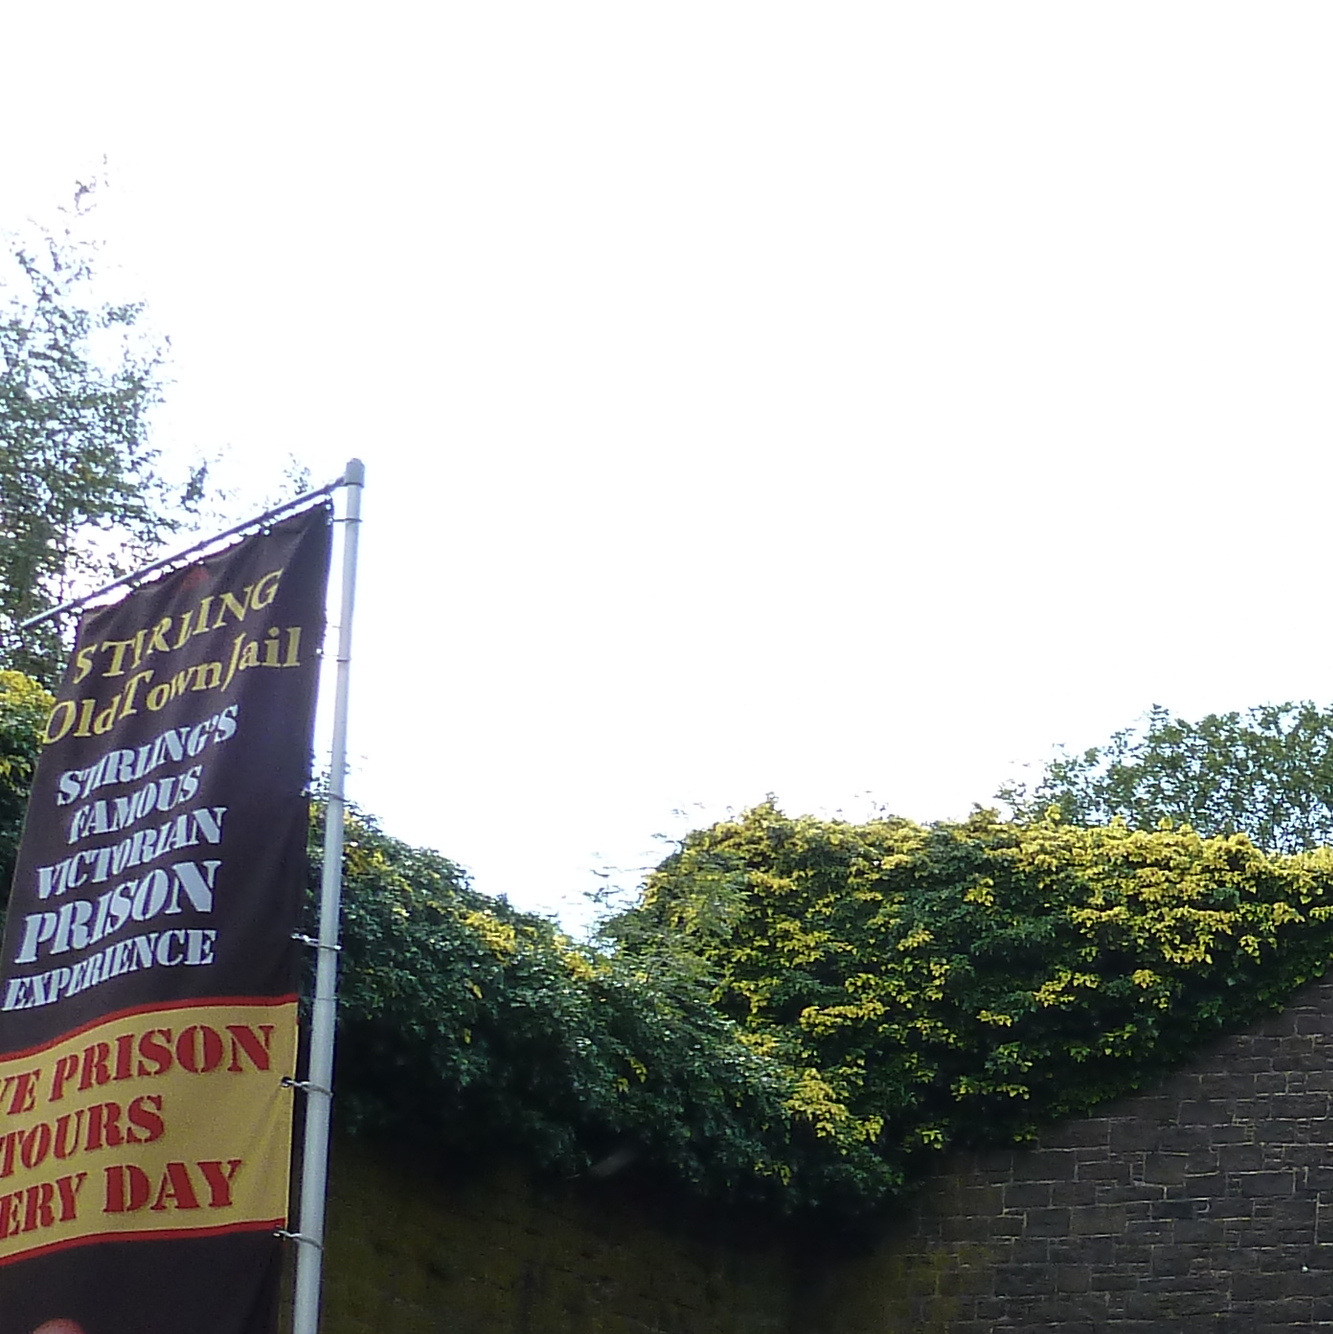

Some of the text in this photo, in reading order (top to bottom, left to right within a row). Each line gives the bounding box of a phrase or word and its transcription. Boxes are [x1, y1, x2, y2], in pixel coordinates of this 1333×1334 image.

[73, 568, 284, 684] STIRLING
[42, 627, 302, 745] Old Town Jail
[57, 704, 239, 806] STIRLING'S
[68, 765, 203, 845] FAMOUS
[37, 807, 228, 899] VICTORIAN
[14, 860, 222, 964] PRISON
[1, 929, 217, 1011] EXPERIENCE
[48, 1025, 274, 1102] PRISON
[0, 1094, 165, 1179] TOURS
[103, 1160, 243, 1213] DAY
